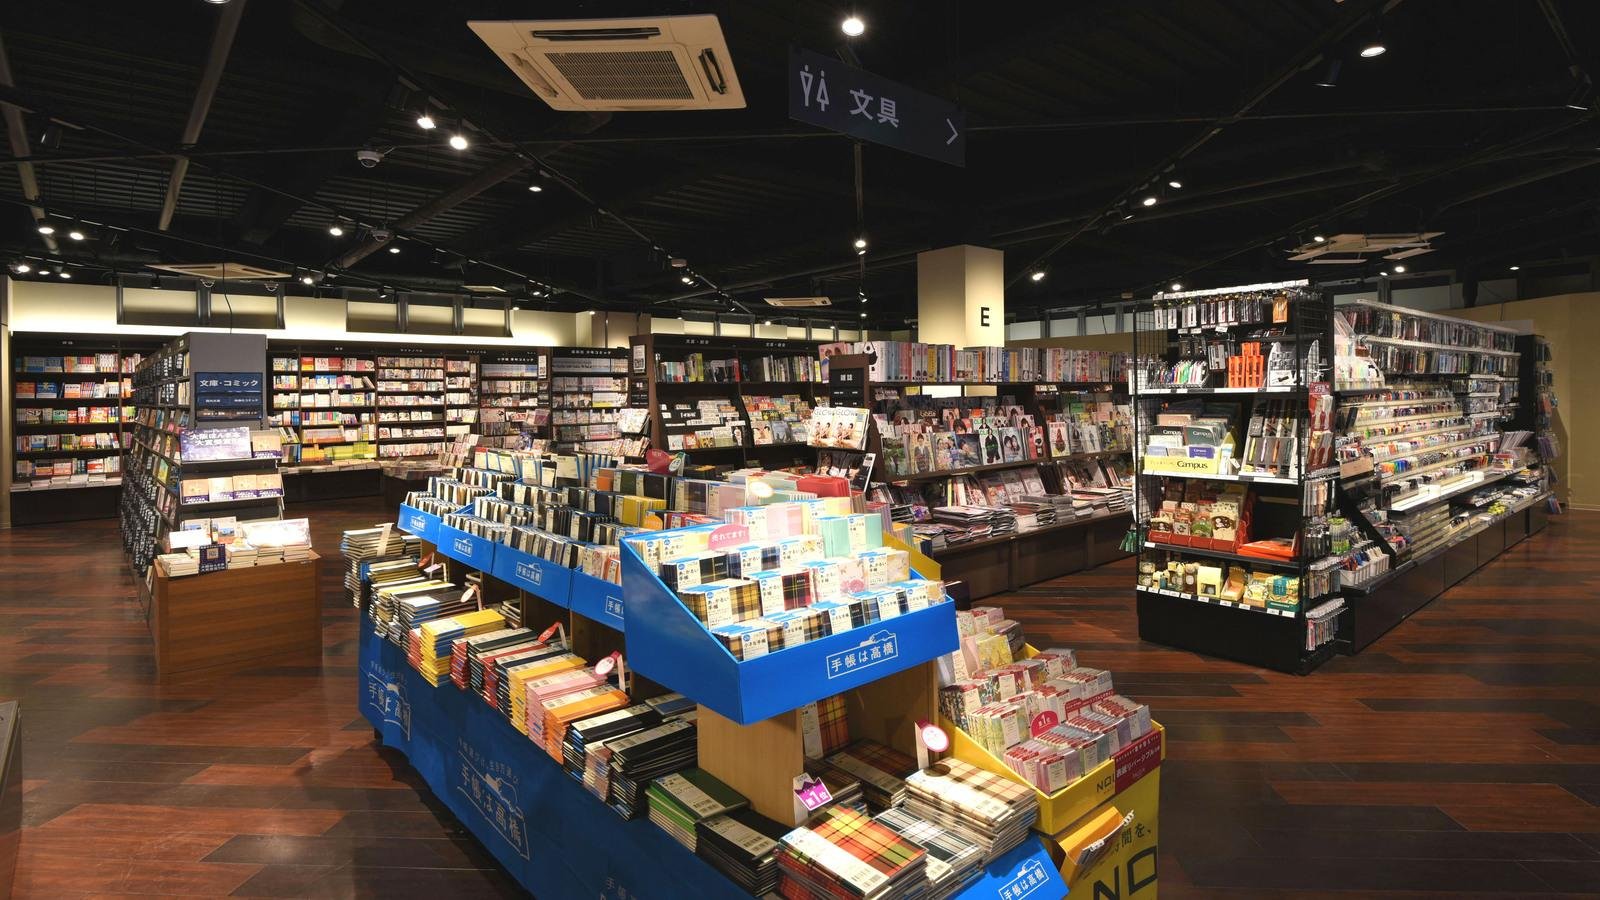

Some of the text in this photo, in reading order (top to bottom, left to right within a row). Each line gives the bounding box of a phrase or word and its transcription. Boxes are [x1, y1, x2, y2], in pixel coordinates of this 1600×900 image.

[849, 89, 899, 128] 文具
[980, 306, 990, 327] E
[200, 379, 259, 387] 文庫・コミック
[1176, 460, 1209, 470] Campus
[831, 641, 894, 673] 手帳は高橋
[461, 763, 522, 847] 手帳は高橋
[1003, 867, 1045, 900] 手帳は高橋
